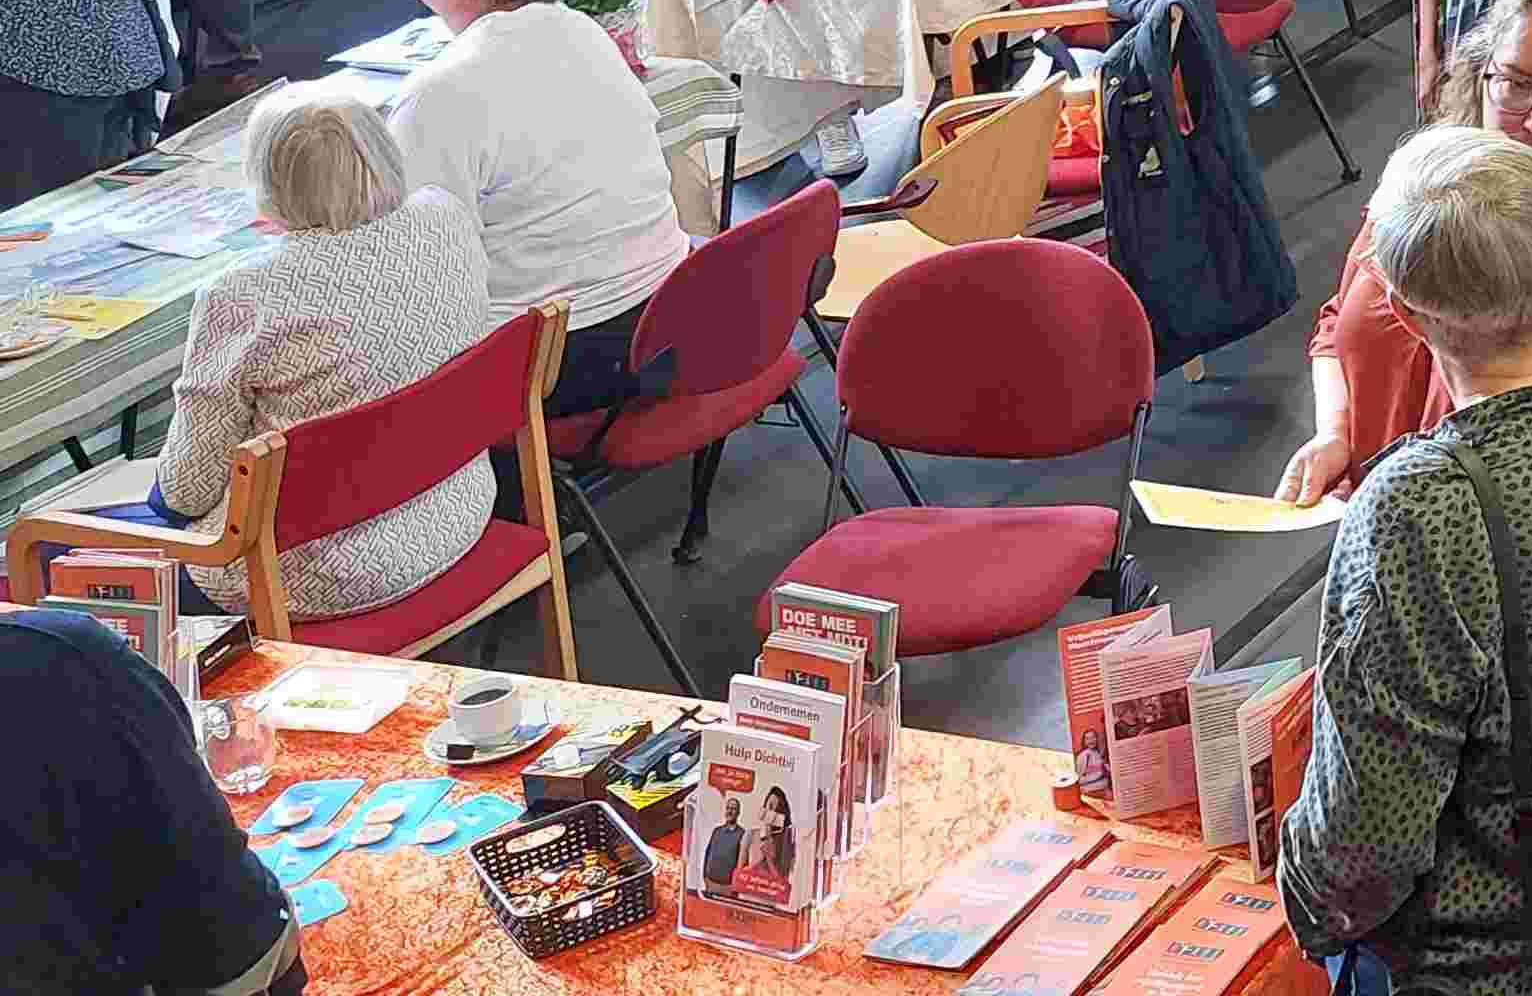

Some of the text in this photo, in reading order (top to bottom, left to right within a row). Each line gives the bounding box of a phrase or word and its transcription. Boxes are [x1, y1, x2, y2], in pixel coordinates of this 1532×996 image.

[782, 608, 857, 633] DOE MEE
[750, 696, 820, 723] Ondernemen
[725, 742, 796, 772] Hulp Dichtbij
